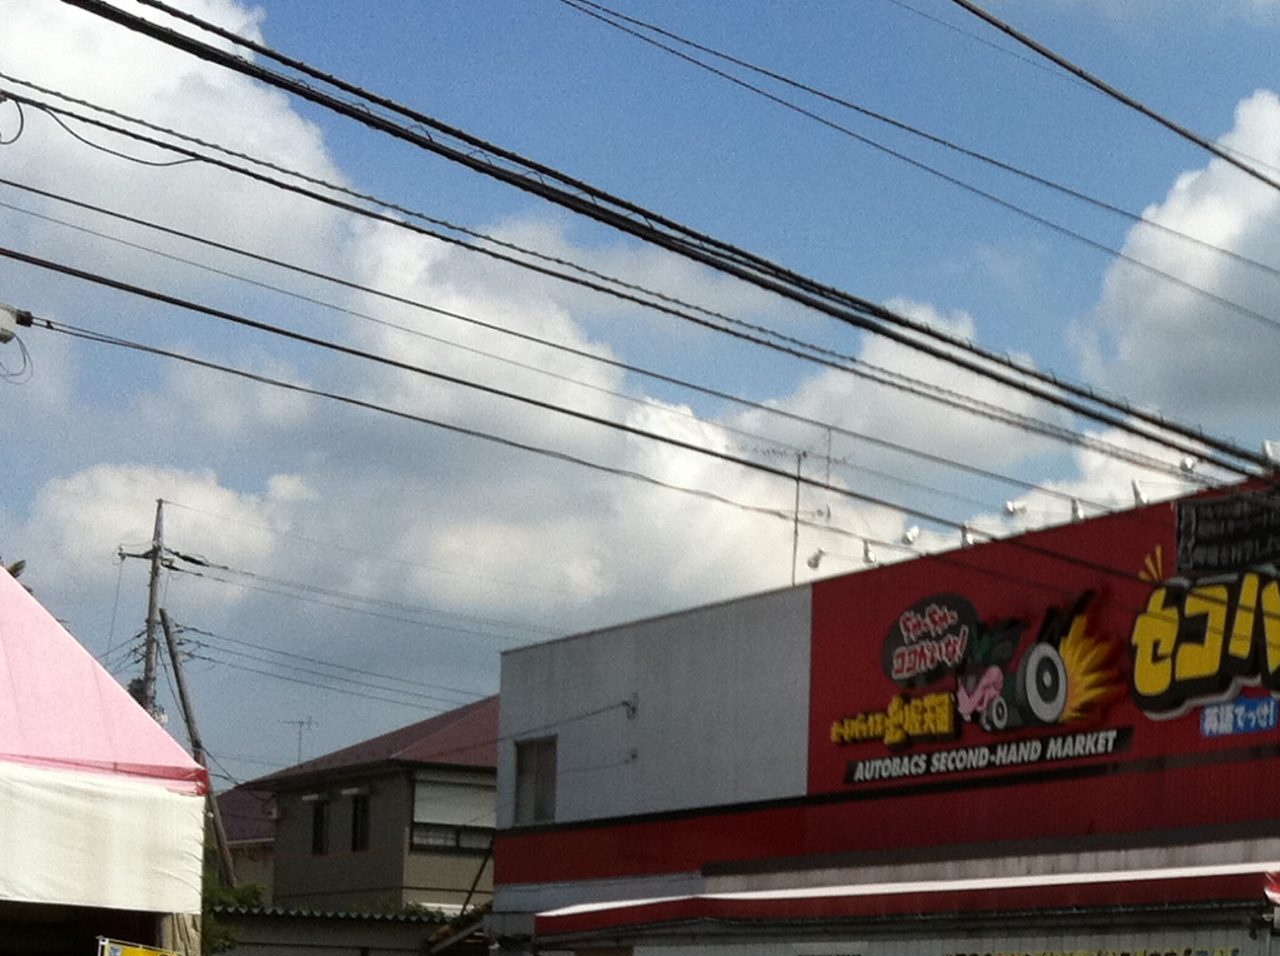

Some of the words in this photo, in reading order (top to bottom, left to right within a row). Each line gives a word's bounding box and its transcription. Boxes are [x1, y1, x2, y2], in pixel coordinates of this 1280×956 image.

[853, 753, 928, 783] AUTOBACS
[930, 740, 1042, 774] SECOND-HAND
[1046, 729, 1118, 761] MARKET
